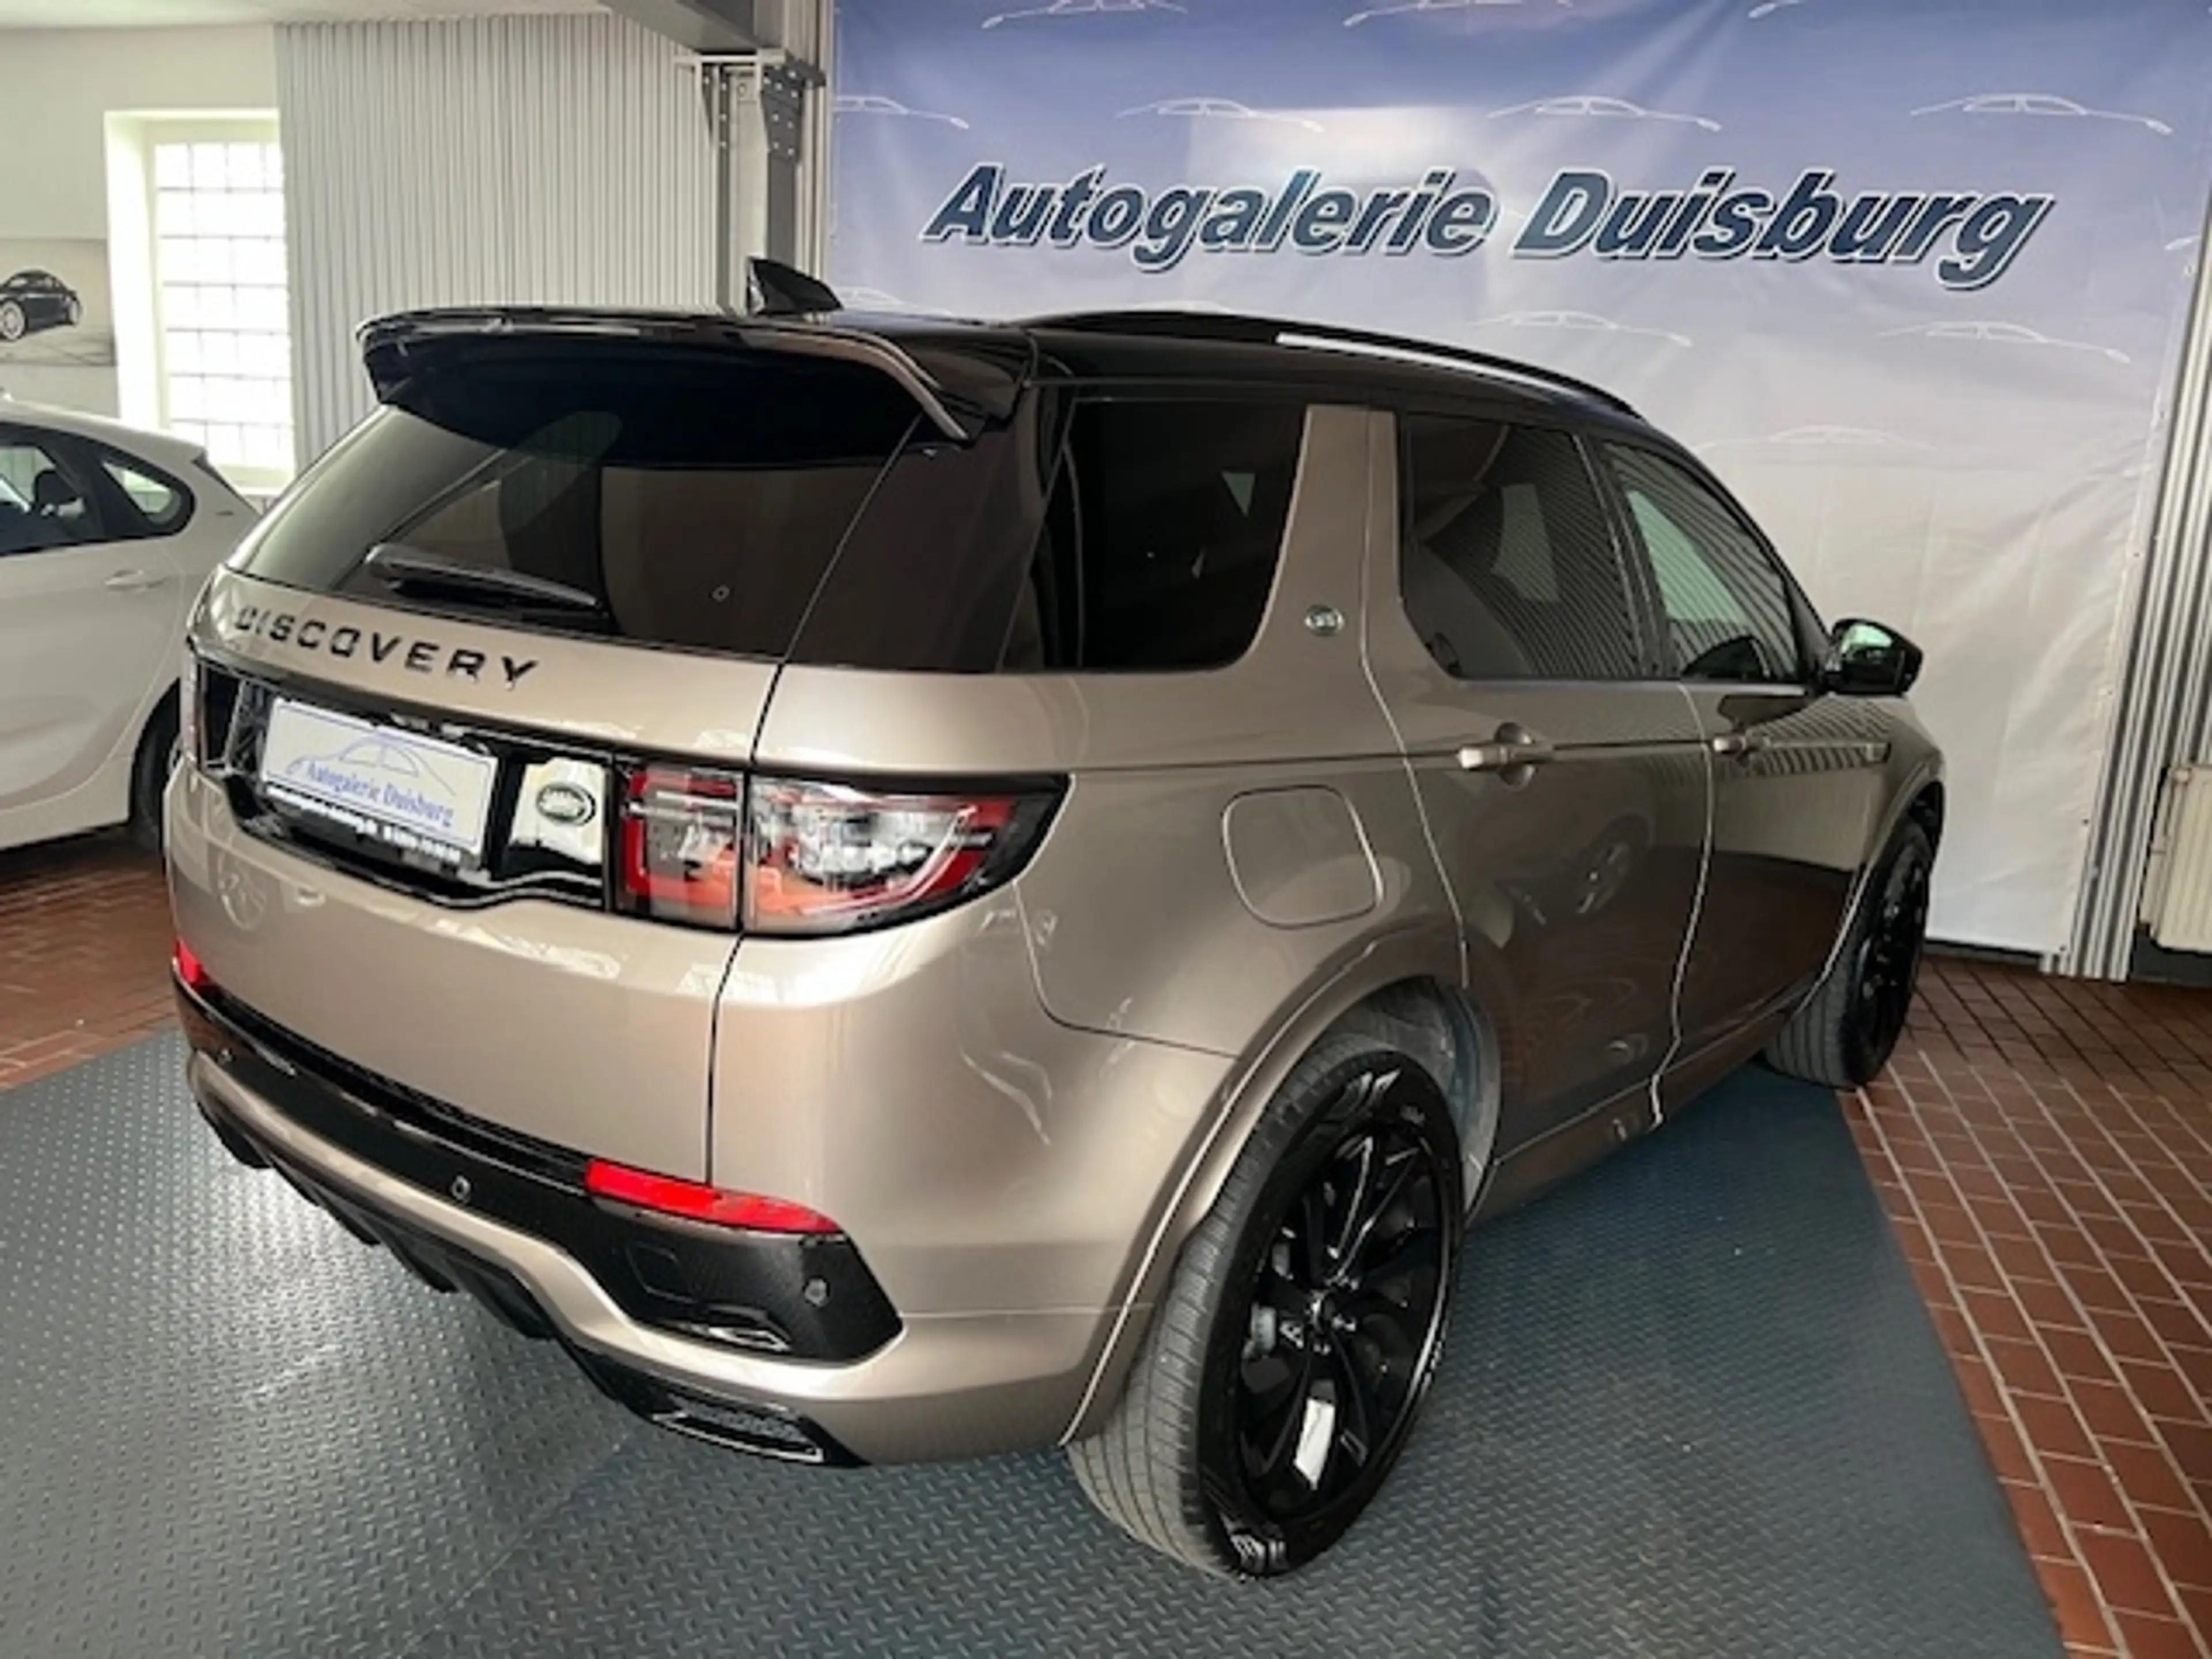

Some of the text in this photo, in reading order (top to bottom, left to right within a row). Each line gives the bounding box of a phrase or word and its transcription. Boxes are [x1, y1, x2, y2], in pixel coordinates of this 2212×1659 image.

[920, 162, 2055, 291] Autogalerie Duisburg
[235, 604, 538, 691] DISCOVERY
